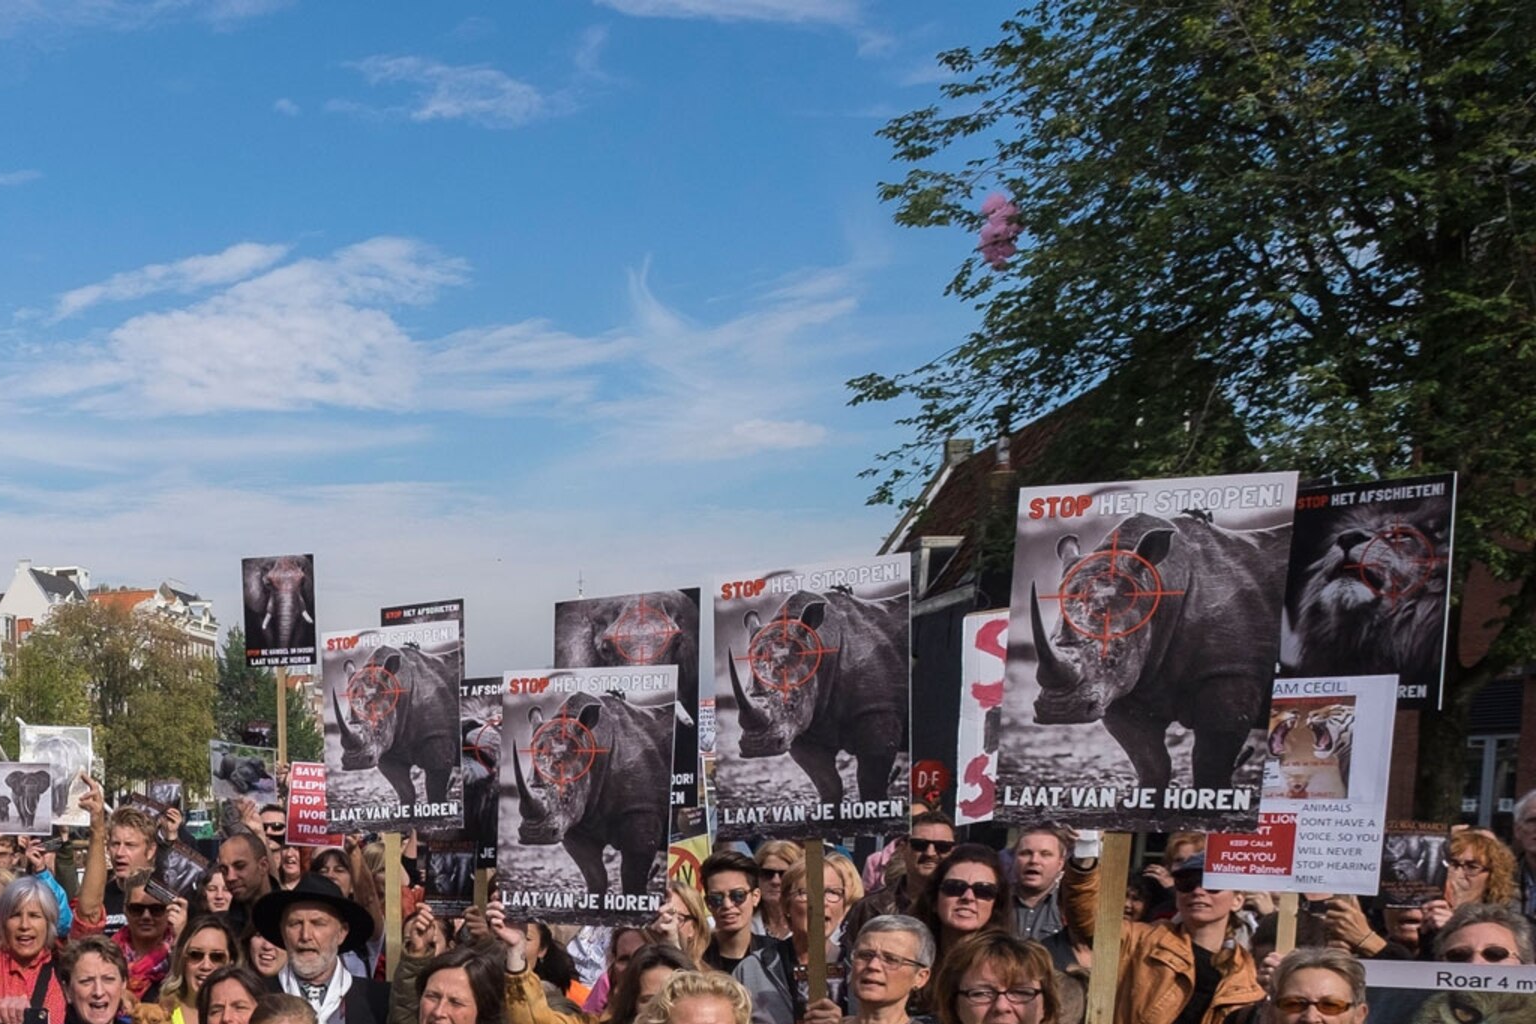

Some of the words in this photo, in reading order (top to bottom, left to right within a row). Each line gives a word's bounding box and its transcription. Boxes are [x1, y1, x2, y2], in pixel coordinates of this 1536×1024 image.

[1029, 495, 1093, 519] STOP
[1099, 492, 1150, 516] HET
[1155, 484, 1283, 514] STROPEN!
[1297, 495, 1328, 509] STOP
[1331, 492, 1355, 507] HET
[1359, 483, 1445, 505] AFSCHIETEN!
[721, 579, 766, 600] STOP
[771, 576, 804, 594] HET
[811, 563, 900, 590] STROPEN!
[385, 610, 402, 620] STOP
[403, 608, 416, 618] HET
[327, 636, 359, 650] STOP
[363, 633, 386, 648] HET
[388, 627, 453, 644] STROPEN!
[509, 677, 550, 695] STOP
[554, 677, 586, 693] HET
[589, 673, 670, 692] STROPEN!
[1272, 683, 1299, 694] AM
[1304, 681, 1347, 694] CECIL.
[295, 767, 324, 777] SAVE
[292, 795, 321, 805] STOP
[1004, 786, 1062, 807] LAAT
[1071, 787, 1116, 807] VAN
[1123, 787, 1157, 808] JE
[1164, 788, 1250, 810] HOREN
[331, 810, 361, 821] LAAT
[366, 808, 390, 820] VAN
[393, 805, 410, 818] JE
[415, 803, 457, 817] HOREN
[724, 808, 766, 824] LAAT
[773, 805, 806, 822] VAN
[814, 803, 834, 820] JE
[840, 800, 903, 819] HOREN
[1302, 804, 1352, 813] ANIMALS
[1300, 818, 1332, 827] DONT
[1335, 818, 1364, 828] HAVE
[1368, 819, 1376, 828] A
[1299, 832, 1335, 842] VOICE.
[1338, 833, 1353, 842] SO
[1355, 833, 1380, 843] YOU
[480, 847, 495, 859] JE
[1297, 847, 1324, 856] WILL
[1327, 847, 1362, 856] NEVER
[1212, 863, 1247, 873] Walter
[1249, 863, 1287, 874] Palmer
[1296, 860, 1324, 870] STOP
[1327, 861, 1376, 872] HEARING
[502, 891, 538, 907] LAAT
[545, 892, 574, 908] VAN
[577, 894, 599, 910] JE
[604, 894, 660, 911] HOREN
[1436, 972, 1492, 989] Roar
[1498, 977, 1509, 989] 4
